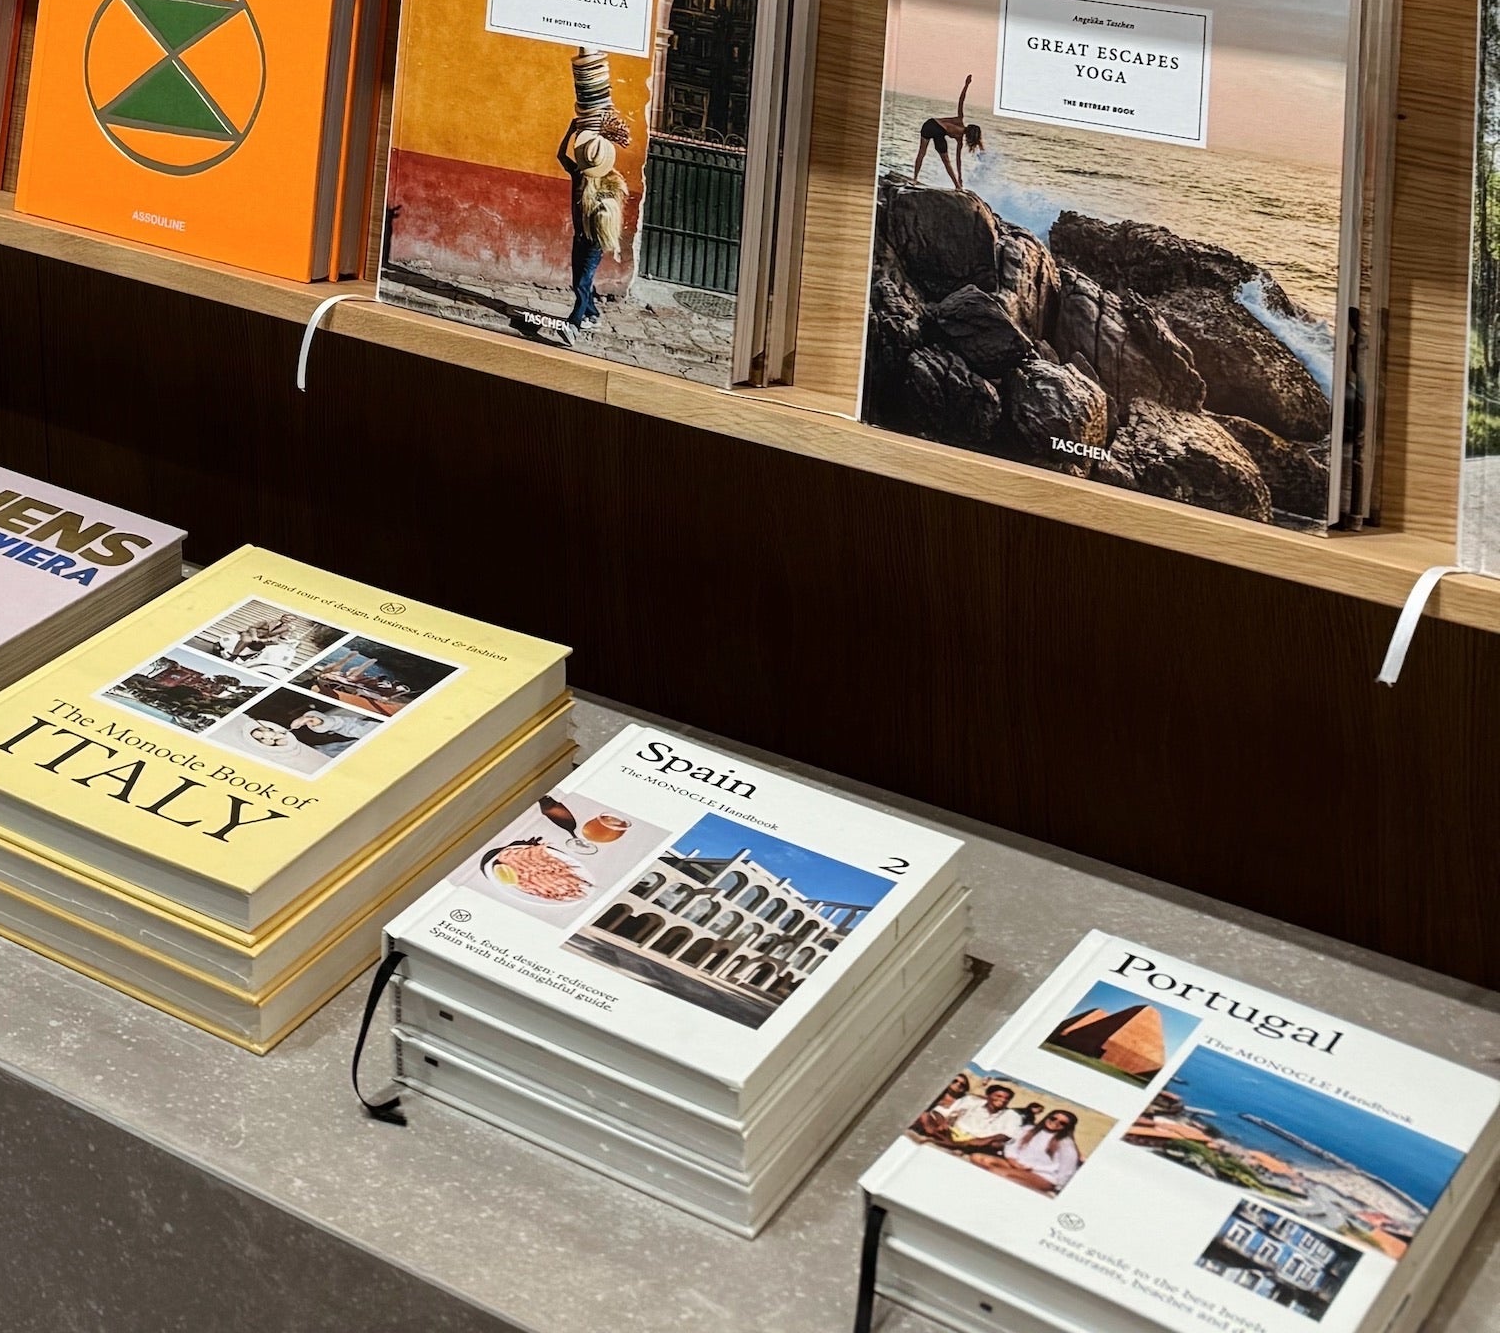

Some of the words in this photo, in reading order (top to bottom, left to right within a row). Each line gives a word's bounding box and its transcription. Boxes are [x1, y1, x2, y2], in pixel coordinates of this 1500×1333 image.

[1072, 15, 1104, 26] Angelika
[1105, 19, 1135, 30] Taschen
[1027, 37, 1089, 56] GREAT
[1096, 46, 1180, 70] ESCAPES
[1075, 64, 1128, 84] YOGA
[1063, 99, 1077, 107] THE
[1078, 101, 1111, 112] RETREAT
[1112, 106, 1136, 116] BOOK
[131, 209, 187, 231] ASSOULINE
[524, 312, 570, 332] TASCHEN
[1050, 436, 1111, 462] TASCHEN
[263, 579, 296, 593] grand
[296, 590, 320, 601] tour
[320, 598, 337, 606] of
[334, 602, 370, 620] design,
[372, 615, 422, 637] business,
[422, 630, 451, 645] food
[450, 638, 467, 648] &
[464, 644, 509, 662] fashion
[48, 698, 97, 728] The
[96, 721, 206, 772] Monocle
[206, 764, 280, 799] Book
[281, 794, 319, 810] of
[636, 741, 758, 800] Spain
[620, 765, 643, 779] The
[643, 775, 716, 808] MONOCLE
[717, 803, 780, 831] Handbook
[879, 857, 910, 875] 2
[429, 926, 463, 947] Spain
[465, 943, 492, 960] with
[493, 955, 517, 970] this
[517, 964, 576, 996] insightful
[575, 993, 613, 1013] guide.
[437, 920, 477, 943] Hotels,
[480, 939, 509, 958] food,
[513, 954, 556, 976] design:
[557, 972, 620, 1003] rediscover
[1109, 952, 1345, 1056] Portugal
[1204, 1035, 1234, 1054] The
[1235, 1047, 1336, 1091] MONOCLE
[1335, 1084, 1415, 1125] Handbook
